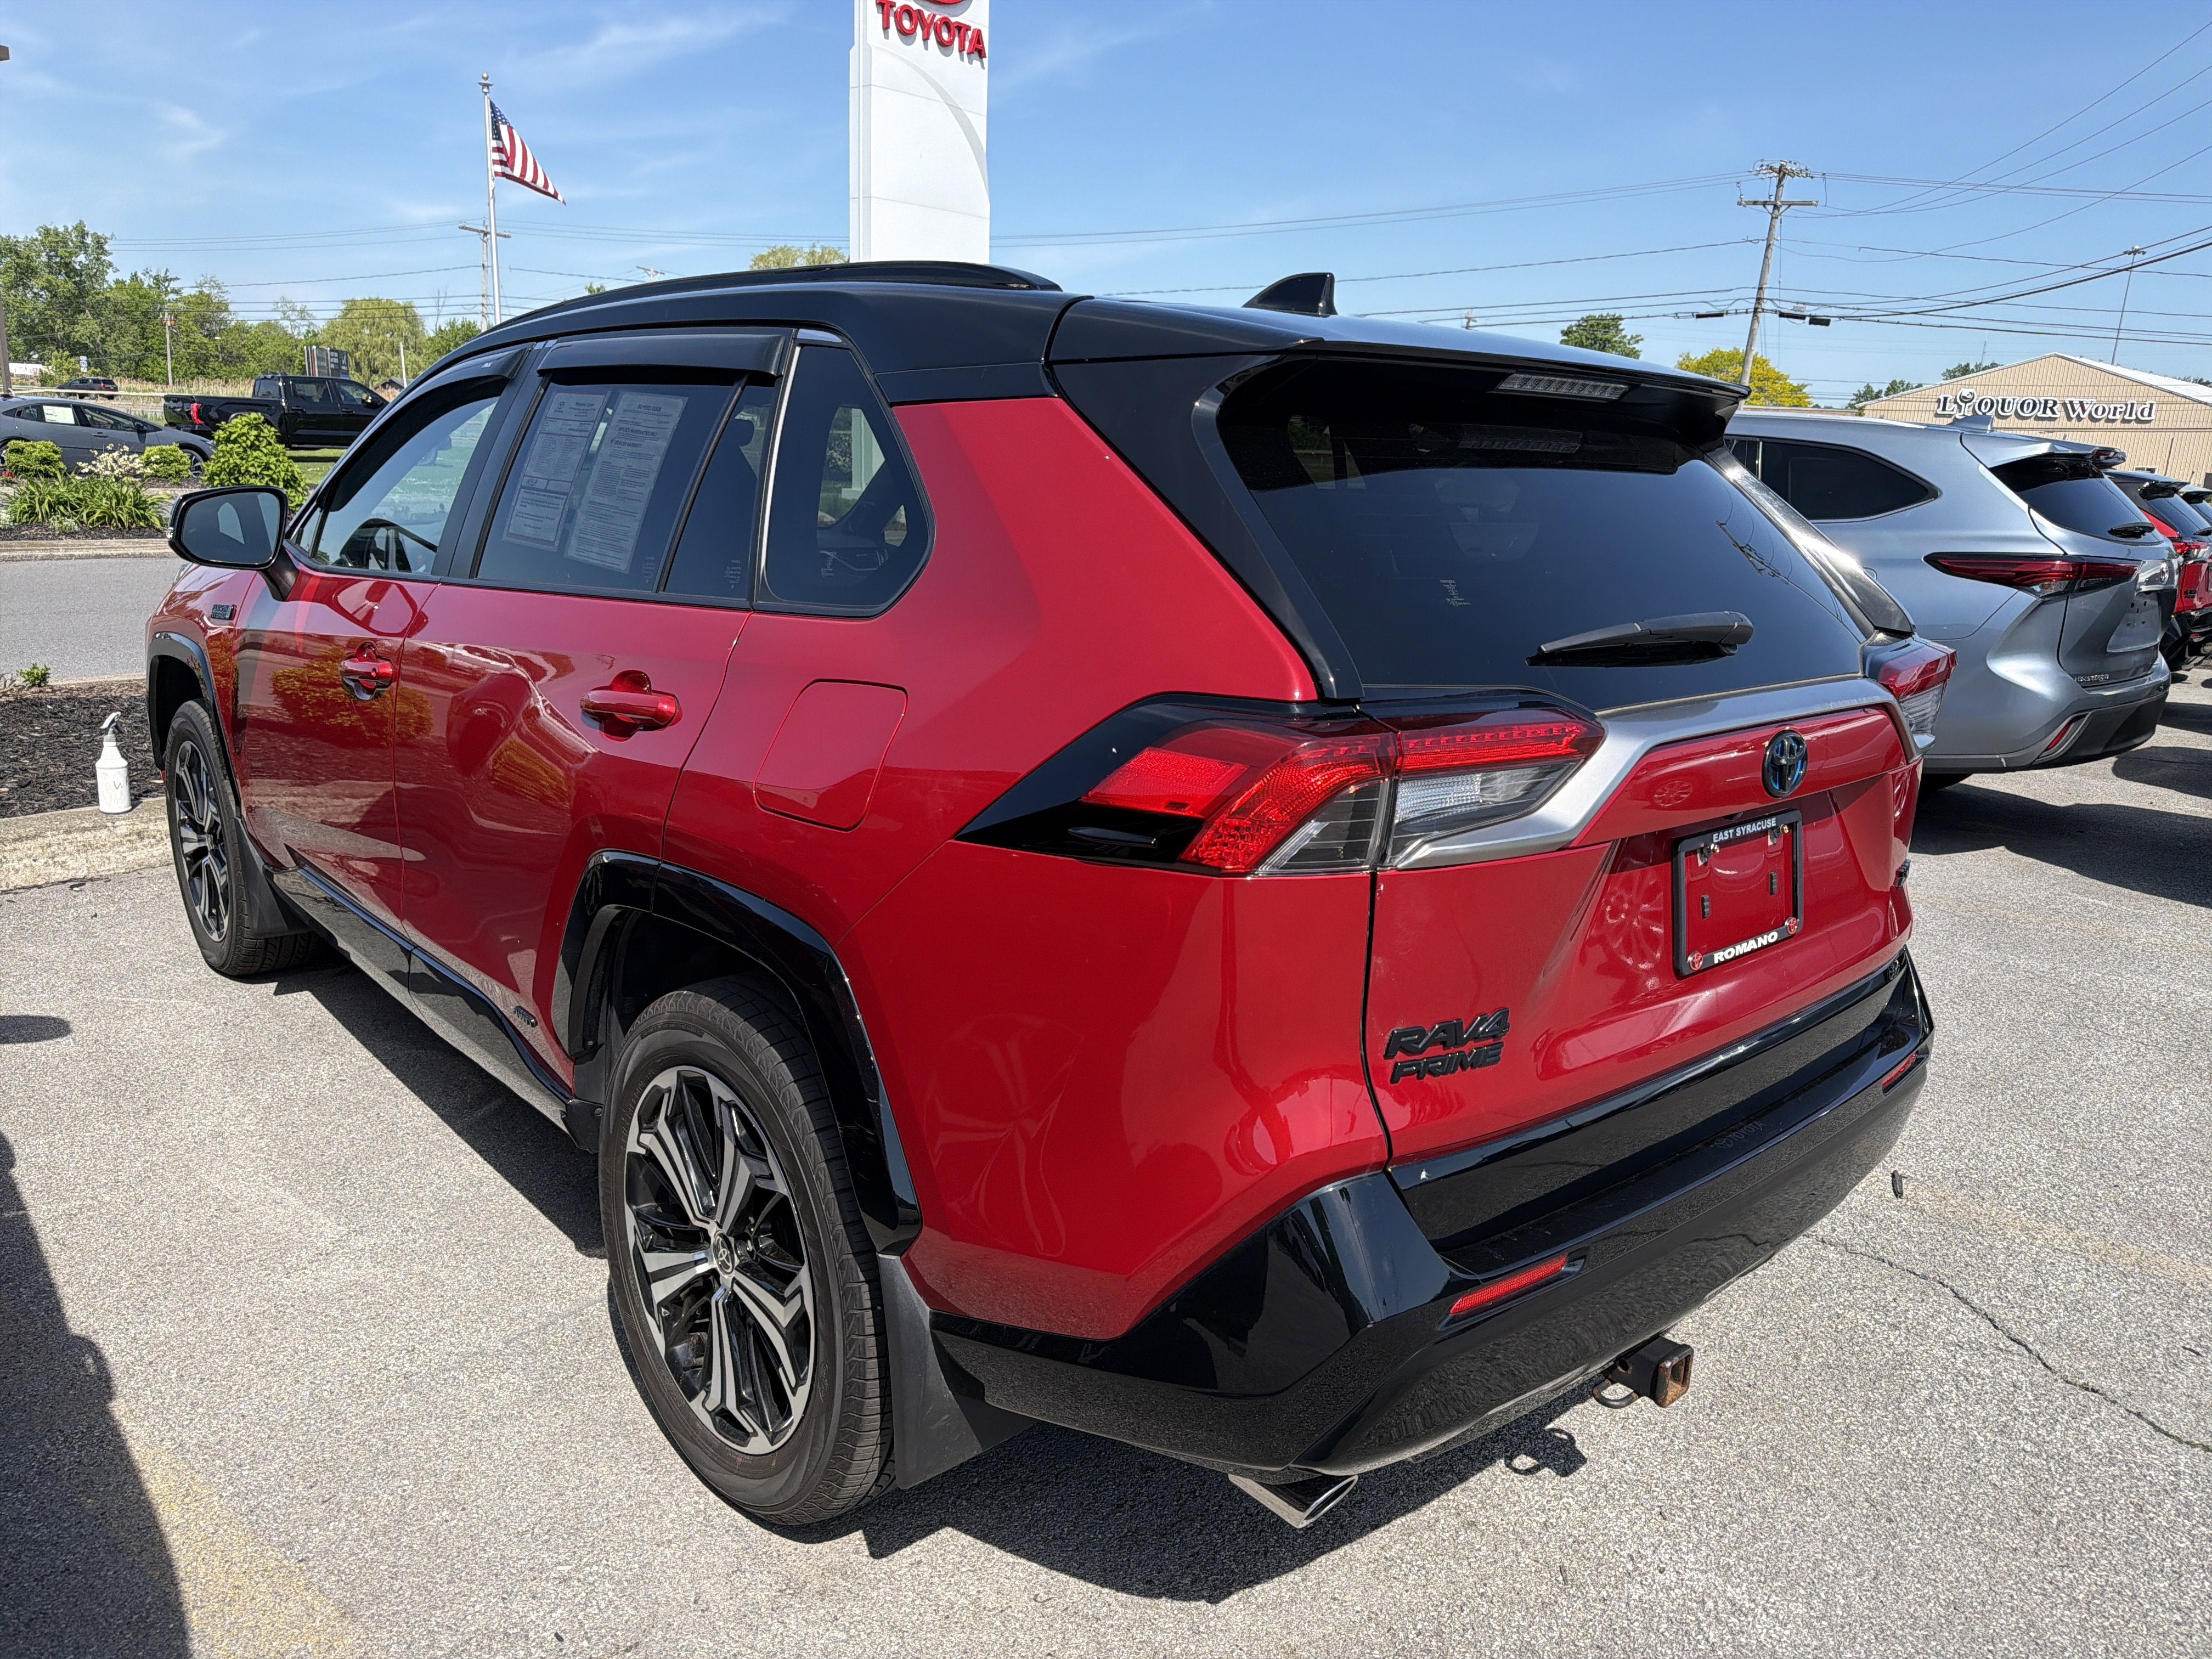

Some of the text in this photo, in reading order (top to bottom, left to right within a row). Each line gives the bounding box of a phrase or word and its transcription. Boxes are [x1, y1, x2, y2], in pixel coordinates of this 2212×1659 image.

[876, 0, 986, 59] TOYOTA
[1937, 388, 2157, 421] LIQUOR World
[1713, 817, 1776, 843] EAST SYRACUSE
[1713, 931, 1778, 964] ROMANO
[1383, 1007, 1510, 1060] RAV4
[1390, 1041, 1504, 1085] PRIME
